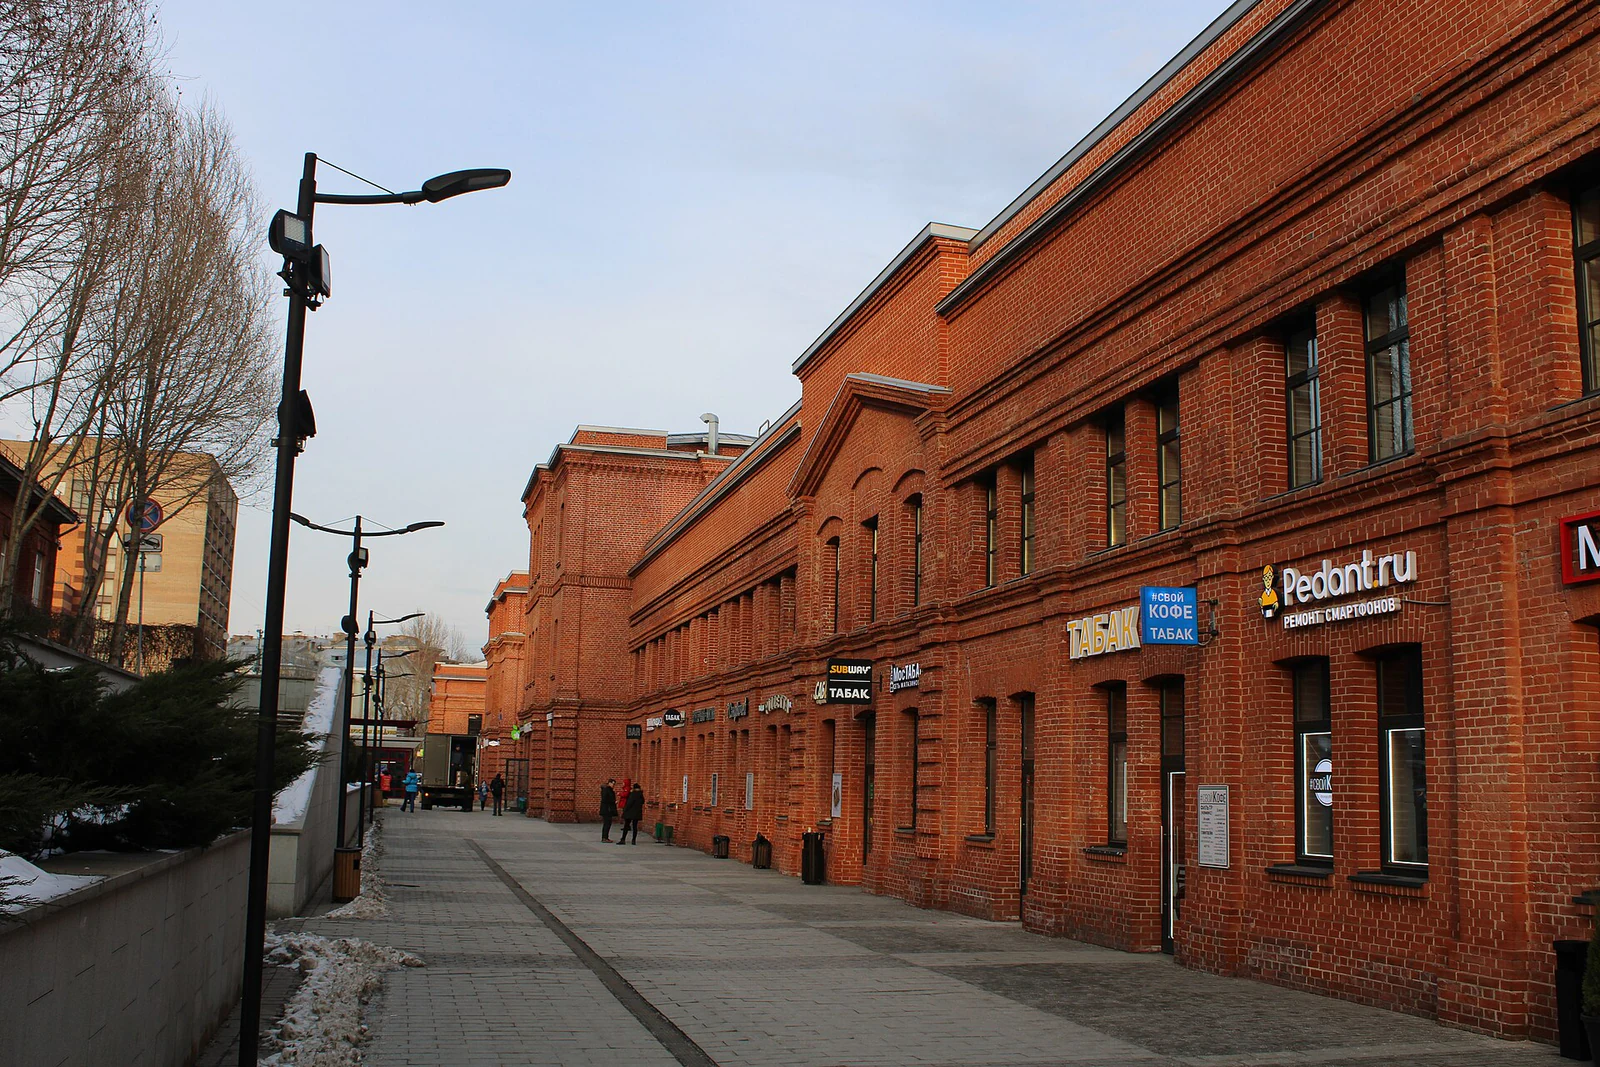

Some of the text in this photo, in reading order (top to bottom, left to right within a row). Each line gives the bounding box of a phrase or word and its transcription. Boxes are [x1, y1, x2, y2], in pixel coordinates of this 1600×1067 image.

[1283, 550, 1417, 606] Pedant.ru
[1151, 591, 1185, 603] #СВОЙ
[1149, 604, 1193, 620] КОФЕ
[1284, 597, 1400, 629] РЕМОНТ СМАРТФОНОВ
[1067, 606, 1140, 660] ТАБАК
[1150, 627, 1194, 641] ТАБАК
[829, 665, 872, 675] SUBWAY
[829, 688, 871, 699] ТАБАК
